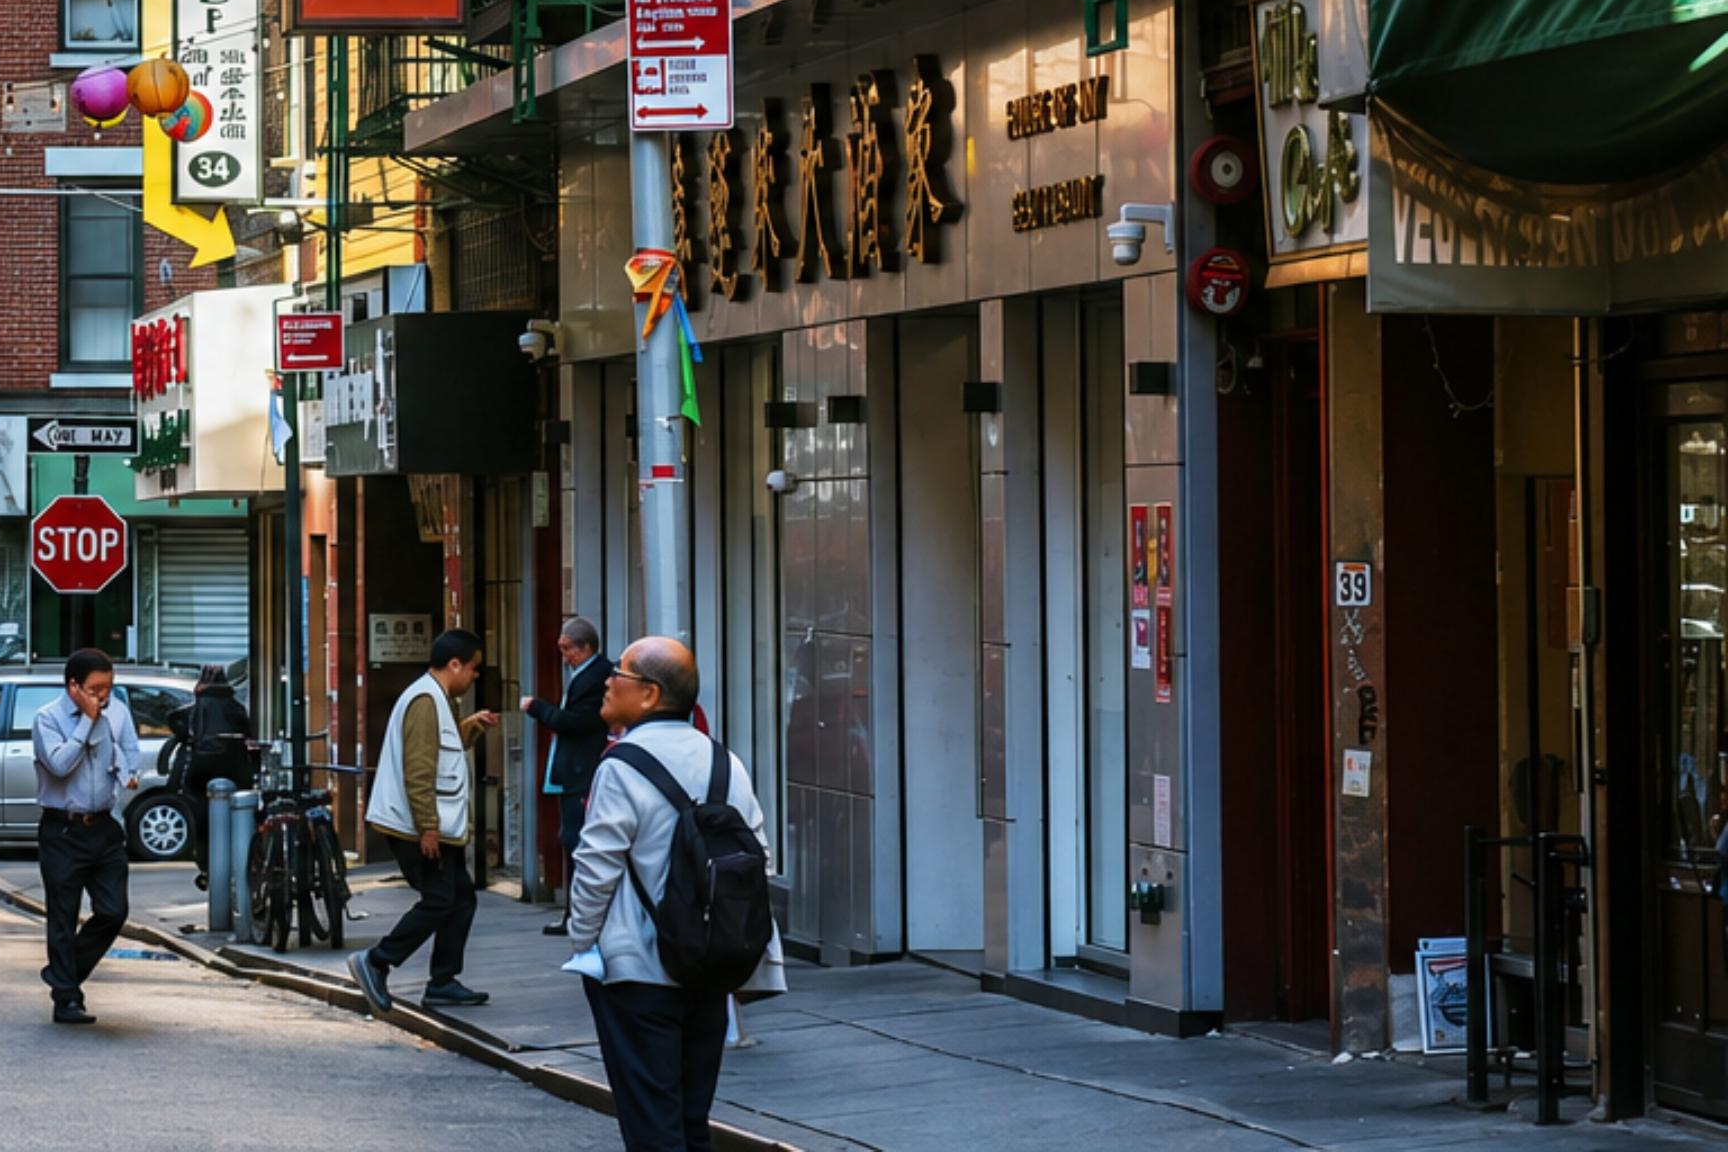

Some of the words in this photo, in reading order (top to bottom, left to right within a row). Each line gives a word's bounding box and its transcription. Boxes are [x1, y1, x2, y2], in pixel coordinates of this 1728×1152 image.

[196, 155, 231, 181] 34
[91, 429, 124, 443] WAY
[37, 526, 120, 562] STOP
